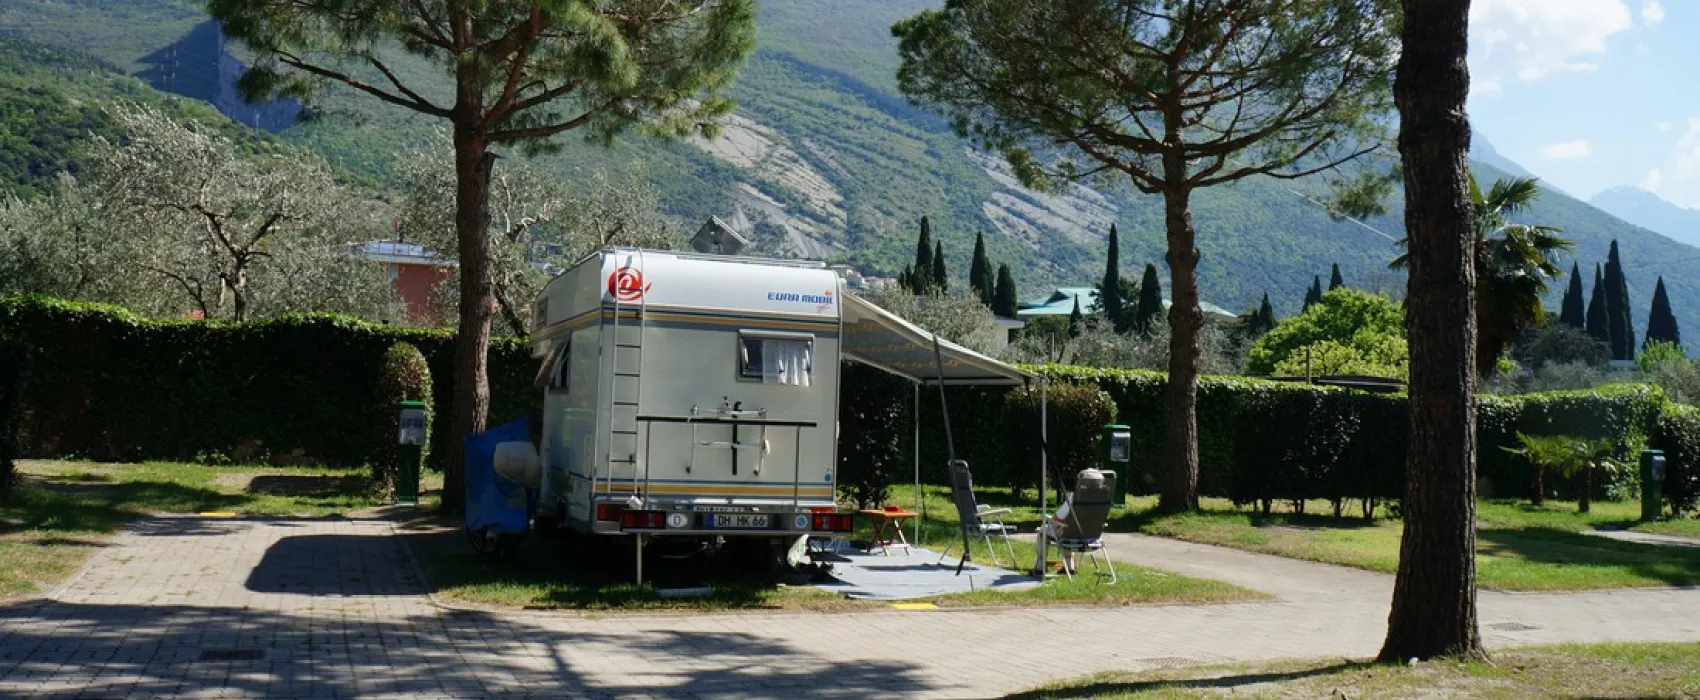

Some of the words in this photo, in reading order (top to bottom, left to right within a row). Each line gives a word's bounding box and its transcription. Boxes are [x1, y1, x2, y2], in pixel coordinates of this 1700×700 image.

[767, 291, 800, 302] EURA
[801, 293, 833, 304] MOBIL
[718, 515, 732, 526] DH
[736, 515, 750, 526] HK
[752, 515, 766, 526] 66
